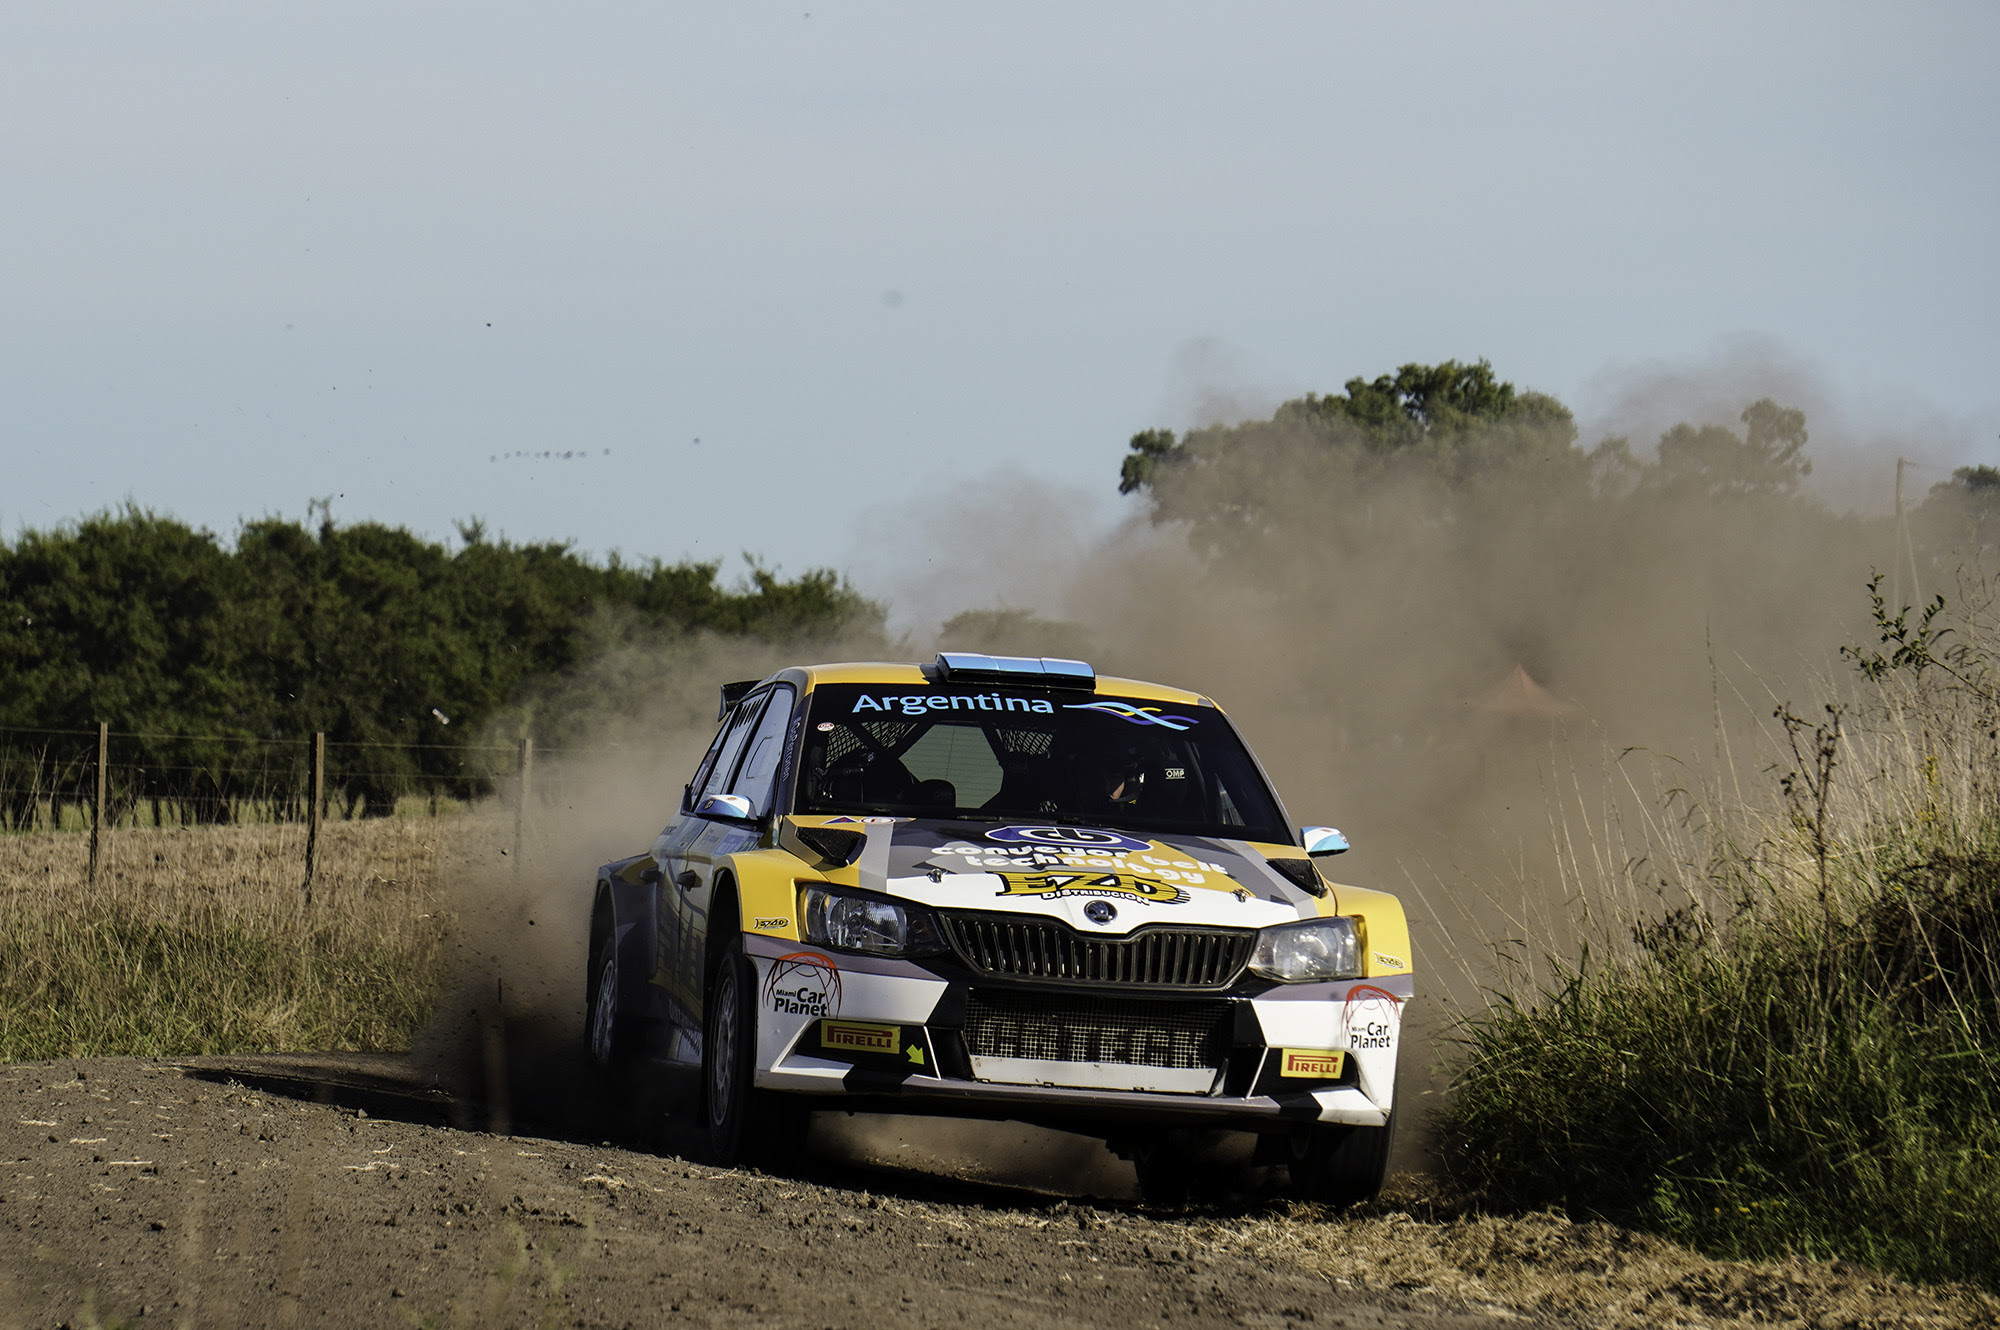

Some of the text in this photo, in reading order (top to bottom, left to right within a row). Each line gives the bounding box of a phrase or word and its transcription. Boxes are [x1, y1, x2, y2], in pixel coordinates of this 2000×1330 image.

[852, 693, 1054, 715] Argentina
[1165, 769, 1185, 779] OMP
[931, 845, 1228, 875] conveyor belt
[964, 853, 1206, 884] technology
[776, 987, 825, 1004] Miami Car
[774, 998, 827, 1017] Planet
[827, 1025, 893, 1048] PIRELLI
[1367, 1022, 1388, 1036] Car
[1351, 1035, 1390, 1049] Planet
[1287, 1054, 1339, 1073] PIRELLI
